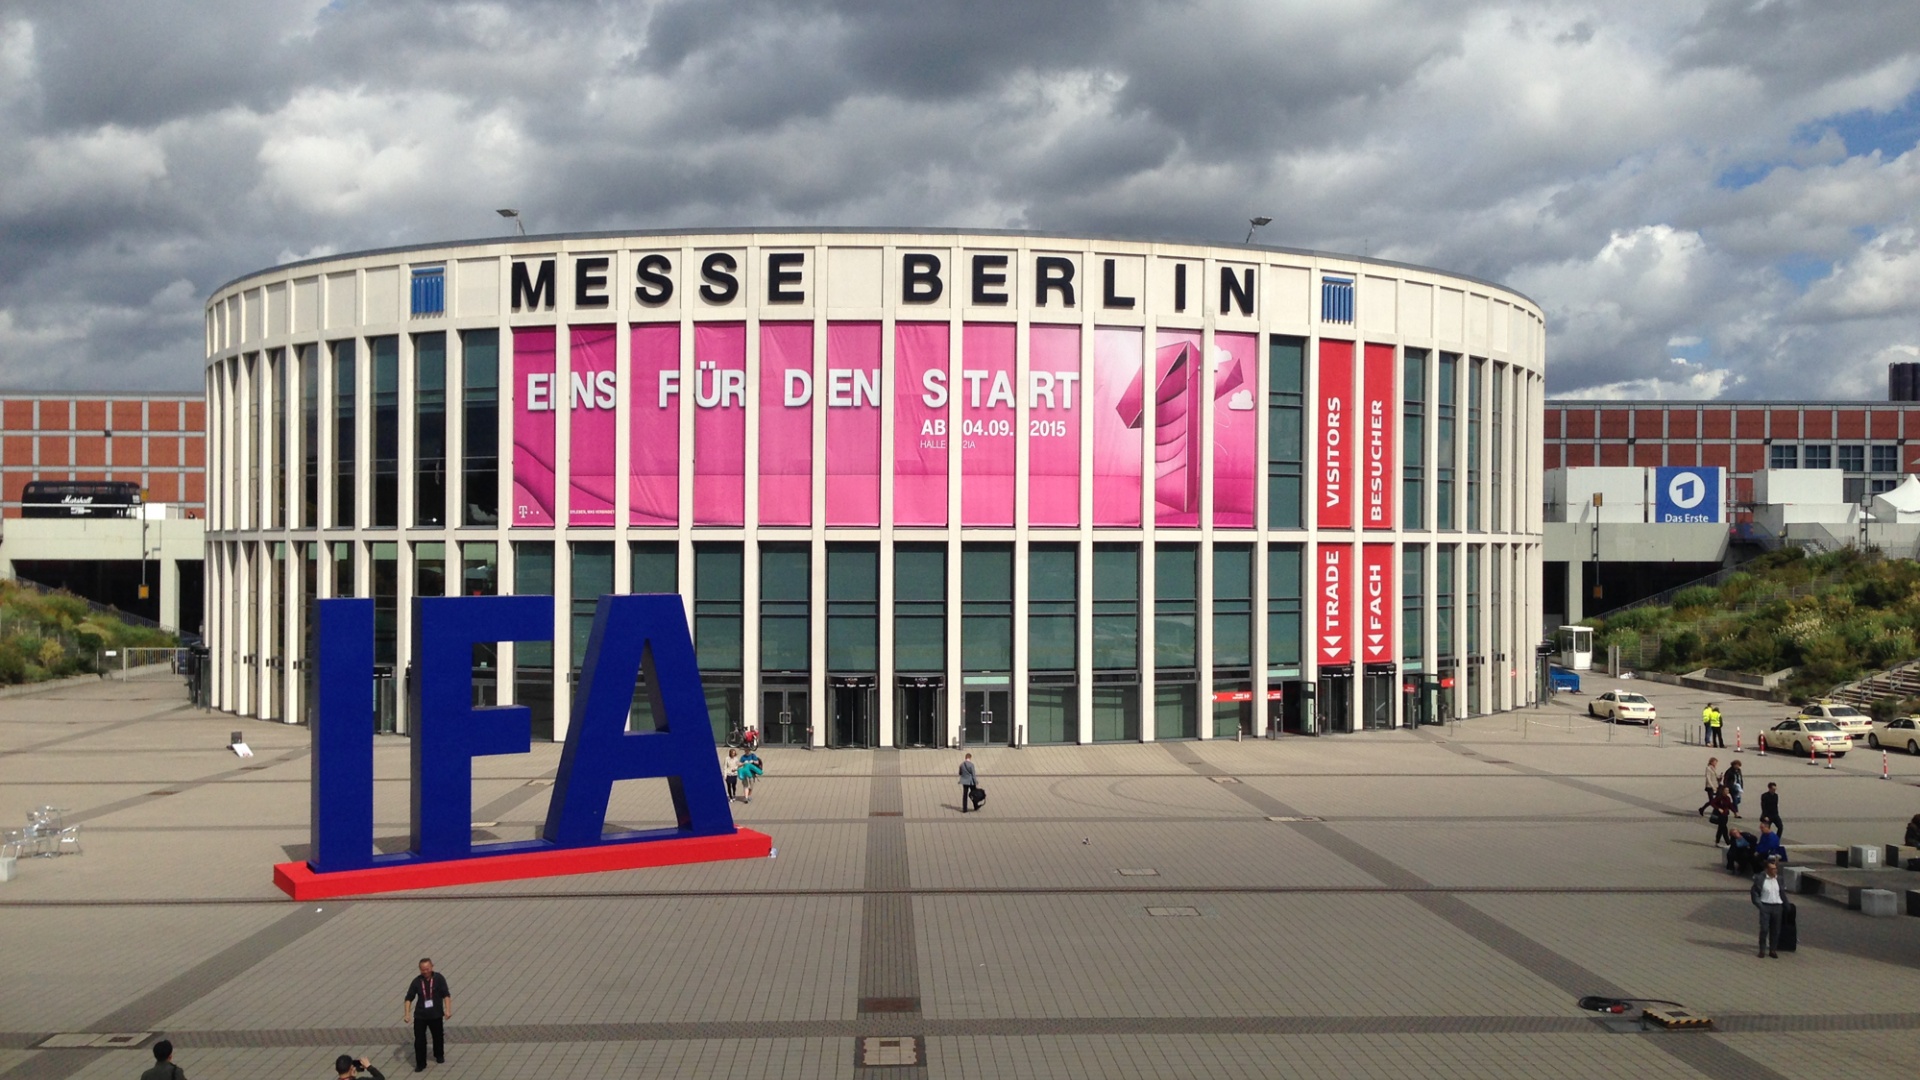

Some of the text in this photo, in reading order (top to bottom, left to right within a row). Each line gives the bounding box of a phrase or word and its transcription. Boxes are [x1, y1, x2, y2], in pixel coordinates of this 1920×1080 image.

[511, 252, 1254, 314] MESSE BERLIN
[527, 361, 1079, 410] EINS FÜR DEN START
[920, 418, 946, 436] AB
[920, 440, 946, 449] HALLE
[61, 494, 94, 504] Marshall
[1325, 397, 1341, 631] TRADE VISITORS
[1369, 400, 1383, 630] FACH BESUCHER
[1665, 513, 1709, 523] Das Erste
[310, 594, 738, 873] IFA
